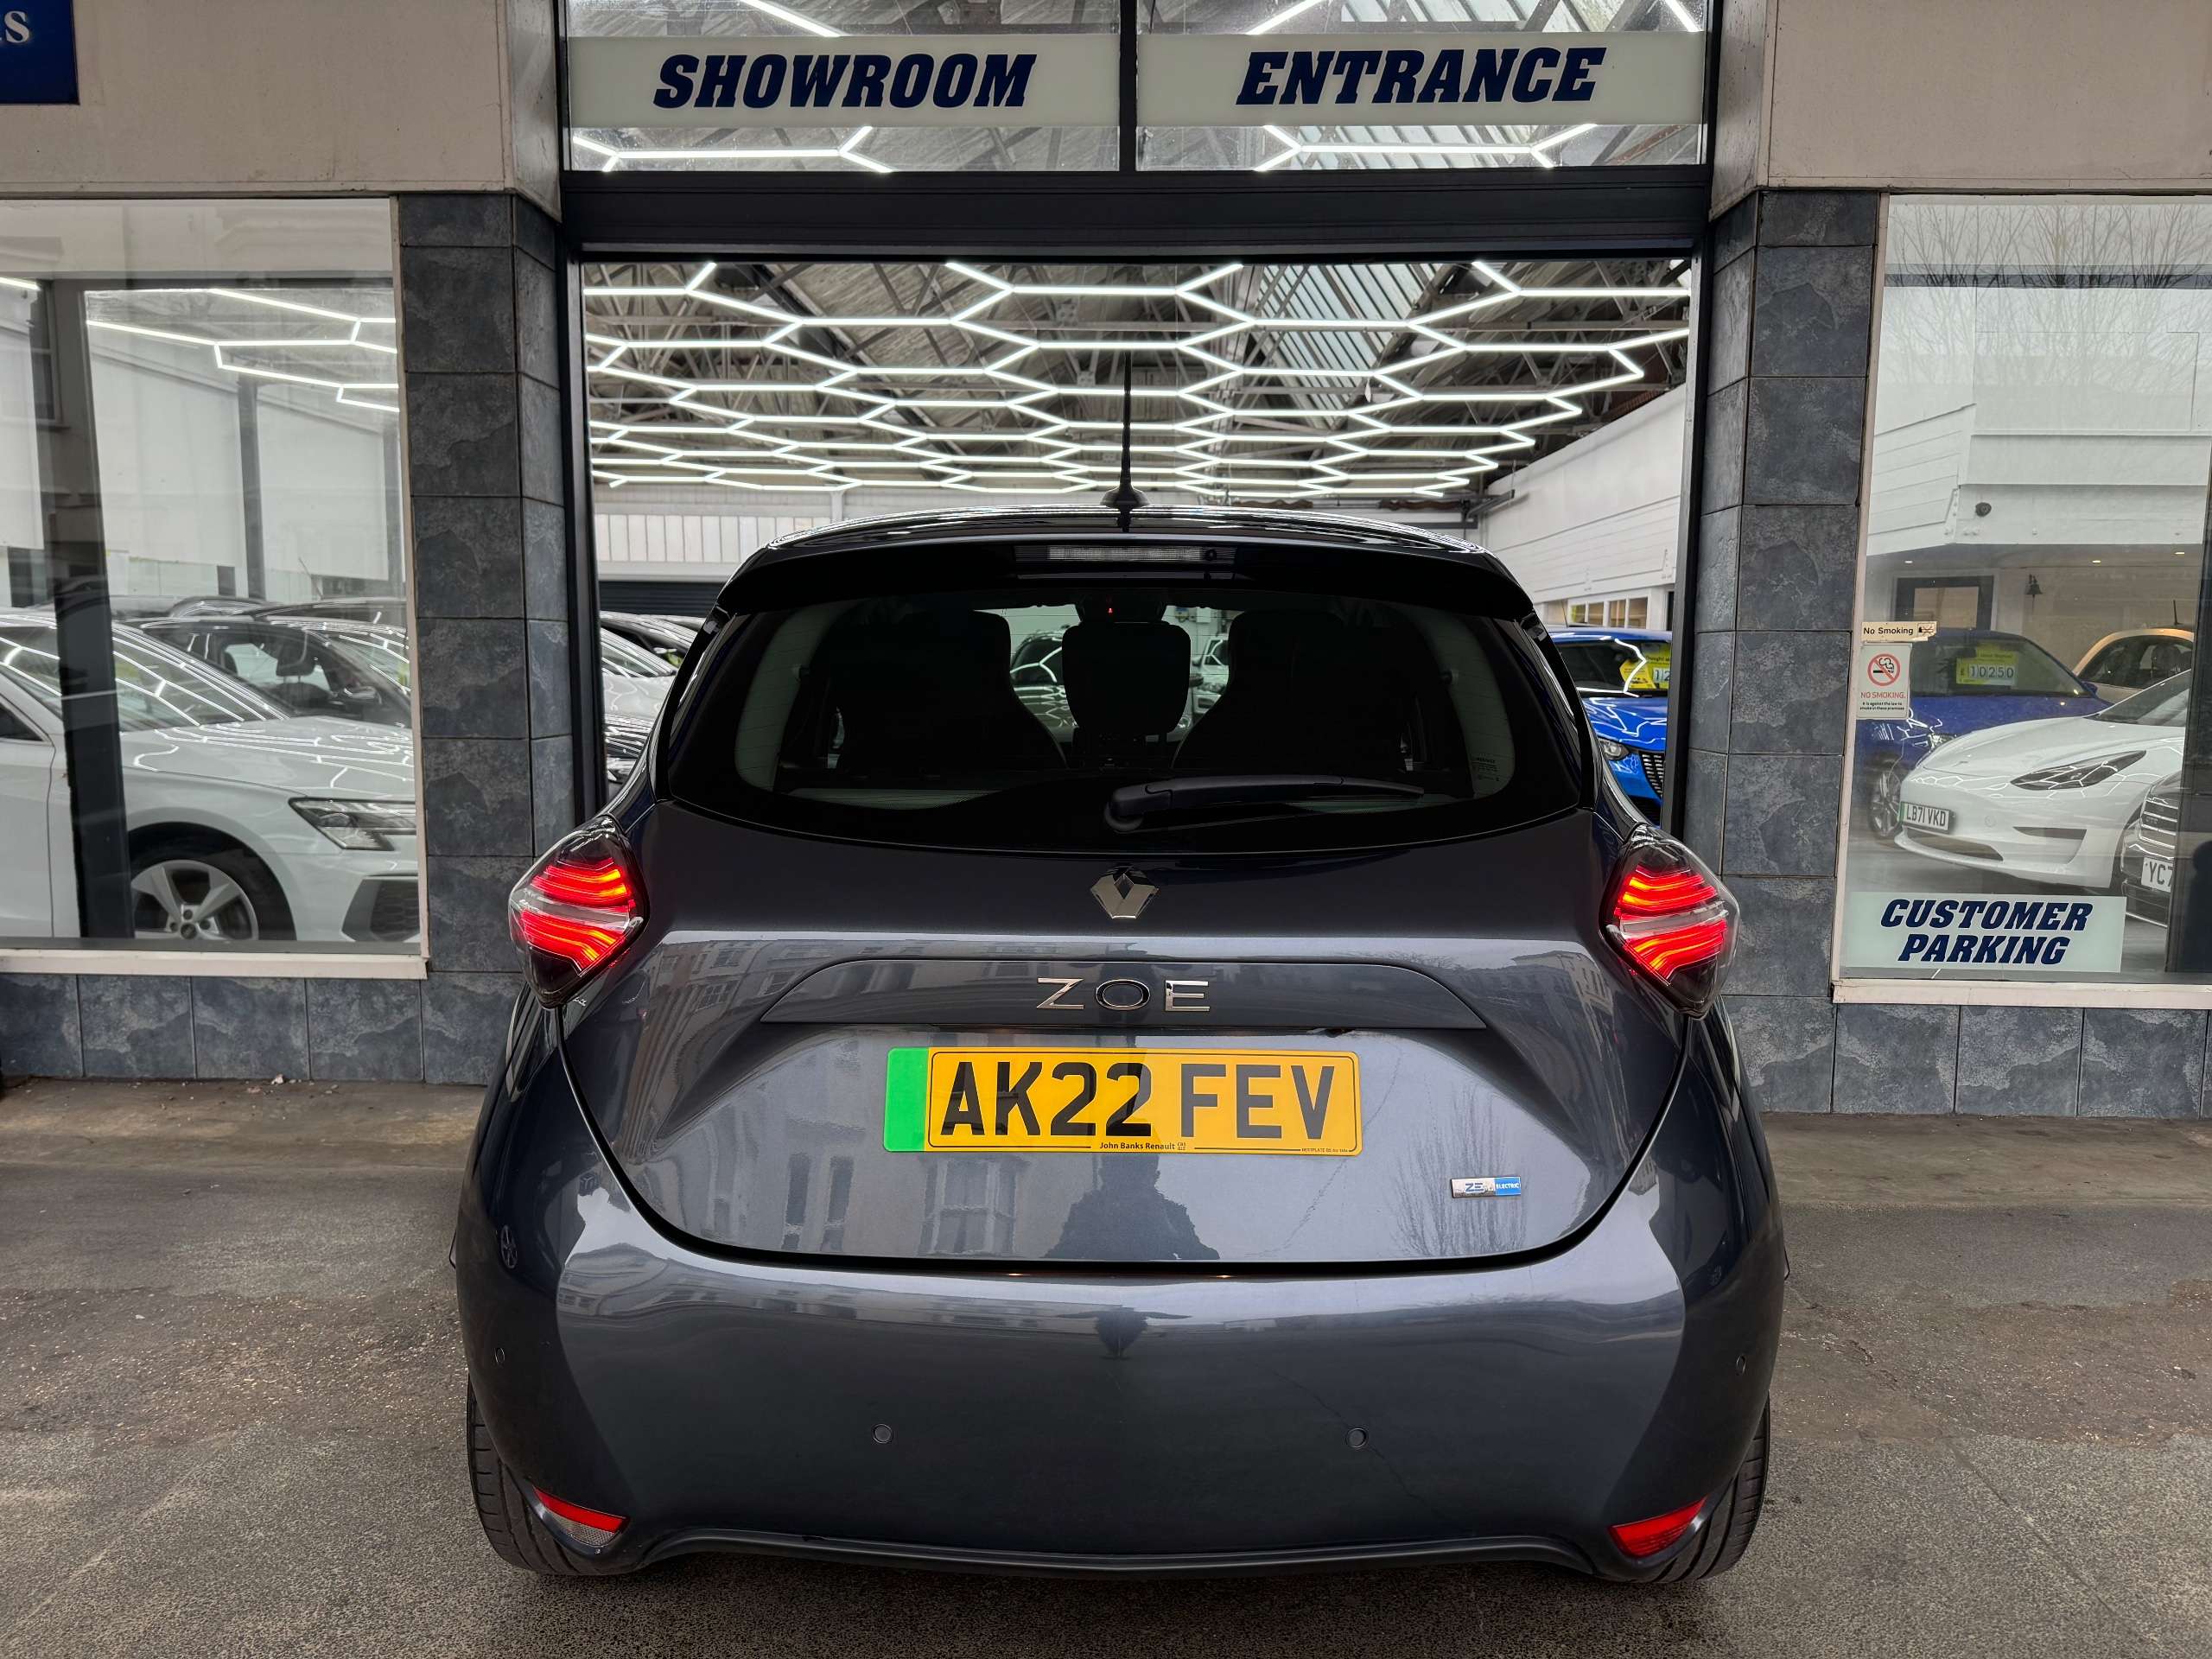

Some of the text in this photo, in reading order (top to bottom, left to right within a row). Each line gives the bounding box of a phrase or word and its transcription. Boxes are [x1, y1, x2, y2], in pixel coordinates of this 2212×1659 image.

[652, 53, 1038, 110] SHOWROOM
[1235, 47, 1607, 105] ENTRANCE
[1878, 626, 1914, 636] Smoking
[1971, 665, 2014, 678] 10250
[1906, 804, 1947, 827] LB71 VKD
[1880, 899, 2094, 931] CUSTOMER
[1897, 933, 2071, 965] PARKING
[1036, 977, 1211, 1012] ZOE
[939, 1061, 1335, 1140] AK22 FEV
[1099, 1141, 1119, 1150] John
[1120, 1141, 1144, 1150] Banks
[1145, 1142, 1176, 1151] Renault
